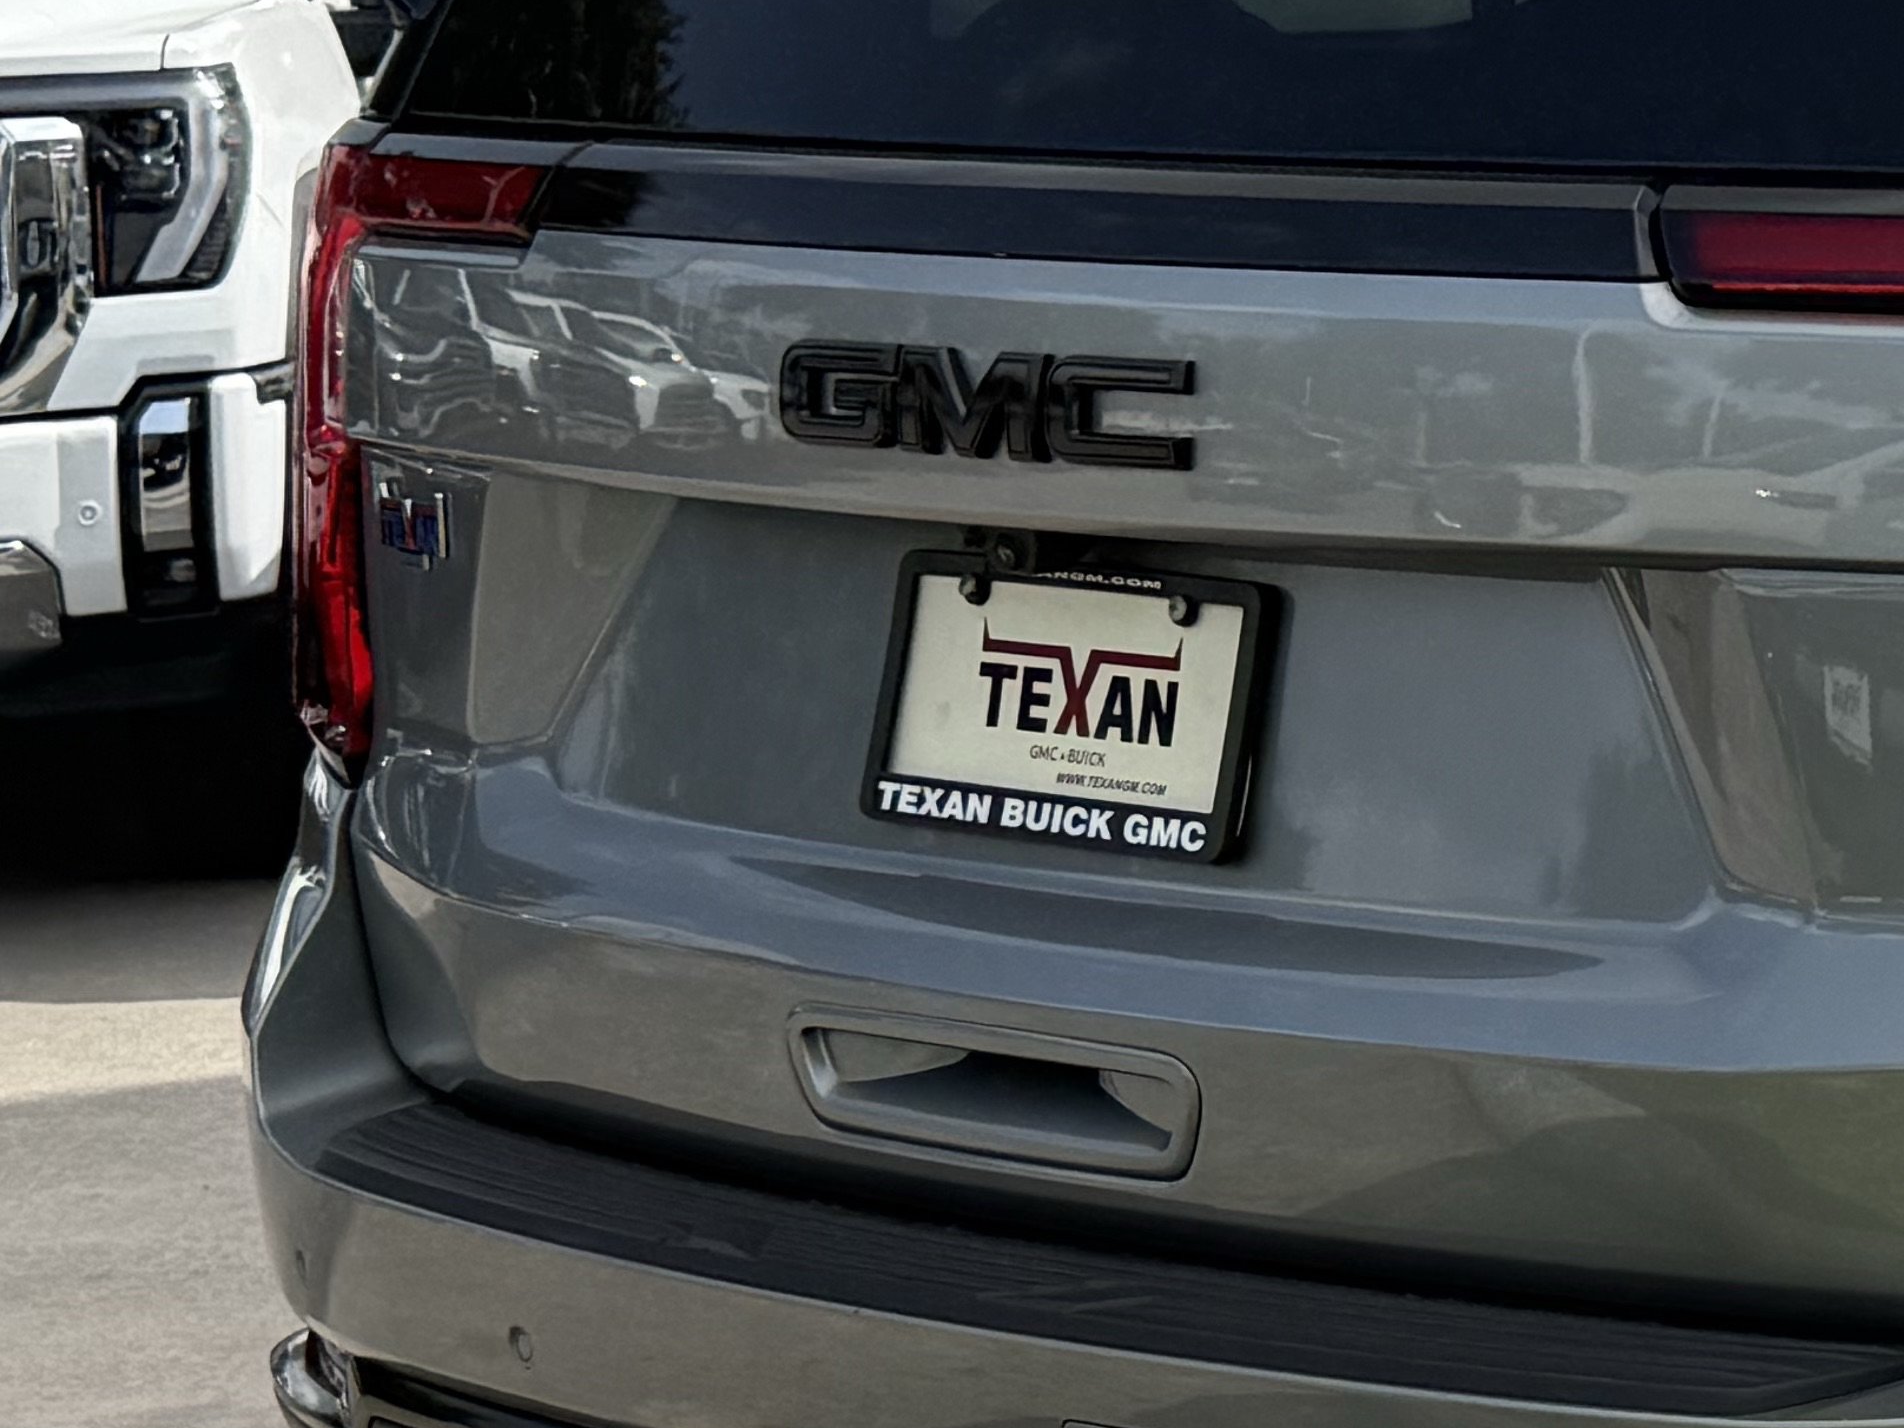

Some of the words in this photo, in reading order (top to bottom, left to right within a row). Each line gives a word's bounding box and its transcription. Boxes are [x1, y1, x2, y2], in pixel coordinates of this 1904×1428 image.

[779, 339, 1196, 471] GMC
[979, 640, 1180, 748] TEXAN
[1067, 749, 1107, 769] BUICK
[877, 780, 993, 825] TEXAN
[1000, 798, 1113, 842] BUICK
[1122, 814, 1207, 853] GMC
